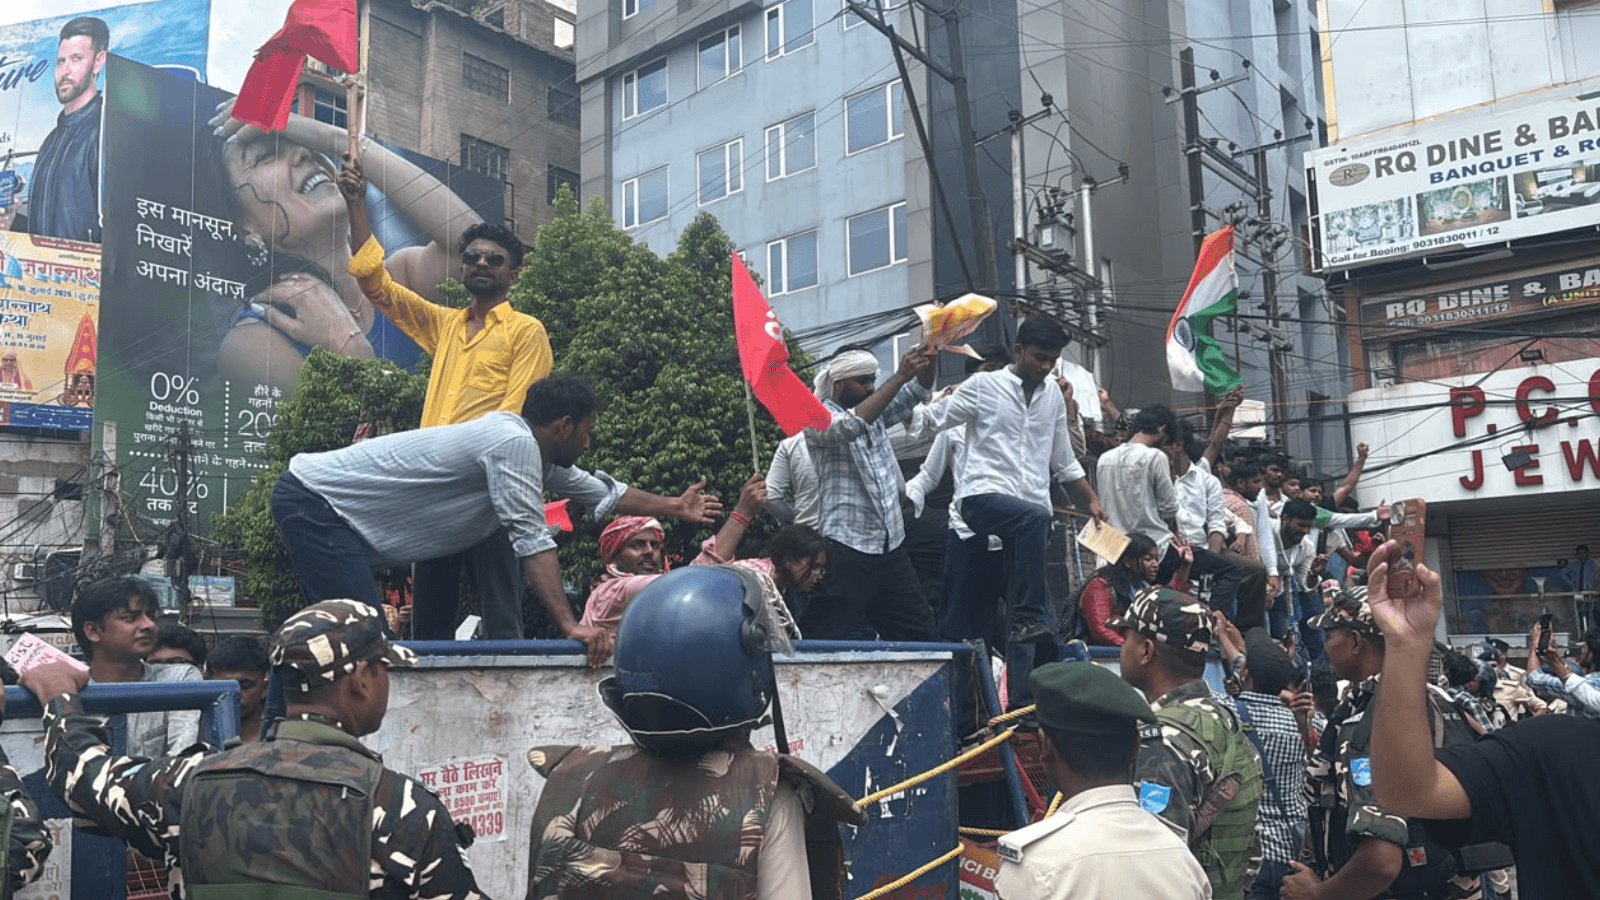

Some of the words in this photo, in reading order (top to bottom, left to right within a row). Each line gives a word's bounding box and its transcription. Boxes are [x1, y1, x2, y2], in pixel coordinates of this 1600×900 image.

[1375, 151, 1417, 178] RQ
[1427, 130, 1503, 167] DINE
[1514, 124, 1538, 147] &
[1548, 107, 1600, 140] BA
[1430, 149, 1545, 185] BANQUET
[1553, 145, 1571, 159] &
[136, 197, 166, 220] इस
[171, 206, 238, 241] मानसून,
[1330, 254, 1351, 264] Call
[1353, 251, 1368, 261] for
[1412, 230, 1478, 249] 9031830011
[1487, 226, 1500, 236] 12
[136, 260, 189, 287] अपना
[194, 271, 246, 299] अंदाज़
[1386, 298, 1426, 319] RQ
[1438, 284, 1511, 310] DINE
[1522, 281, 1547, 297] &
[150, 401, 203, 417] Deduction
[146, 498, 173, 512] तक
[440, 764, 460, 784] बैठे
[462, 758, 502, 781] लिखने
